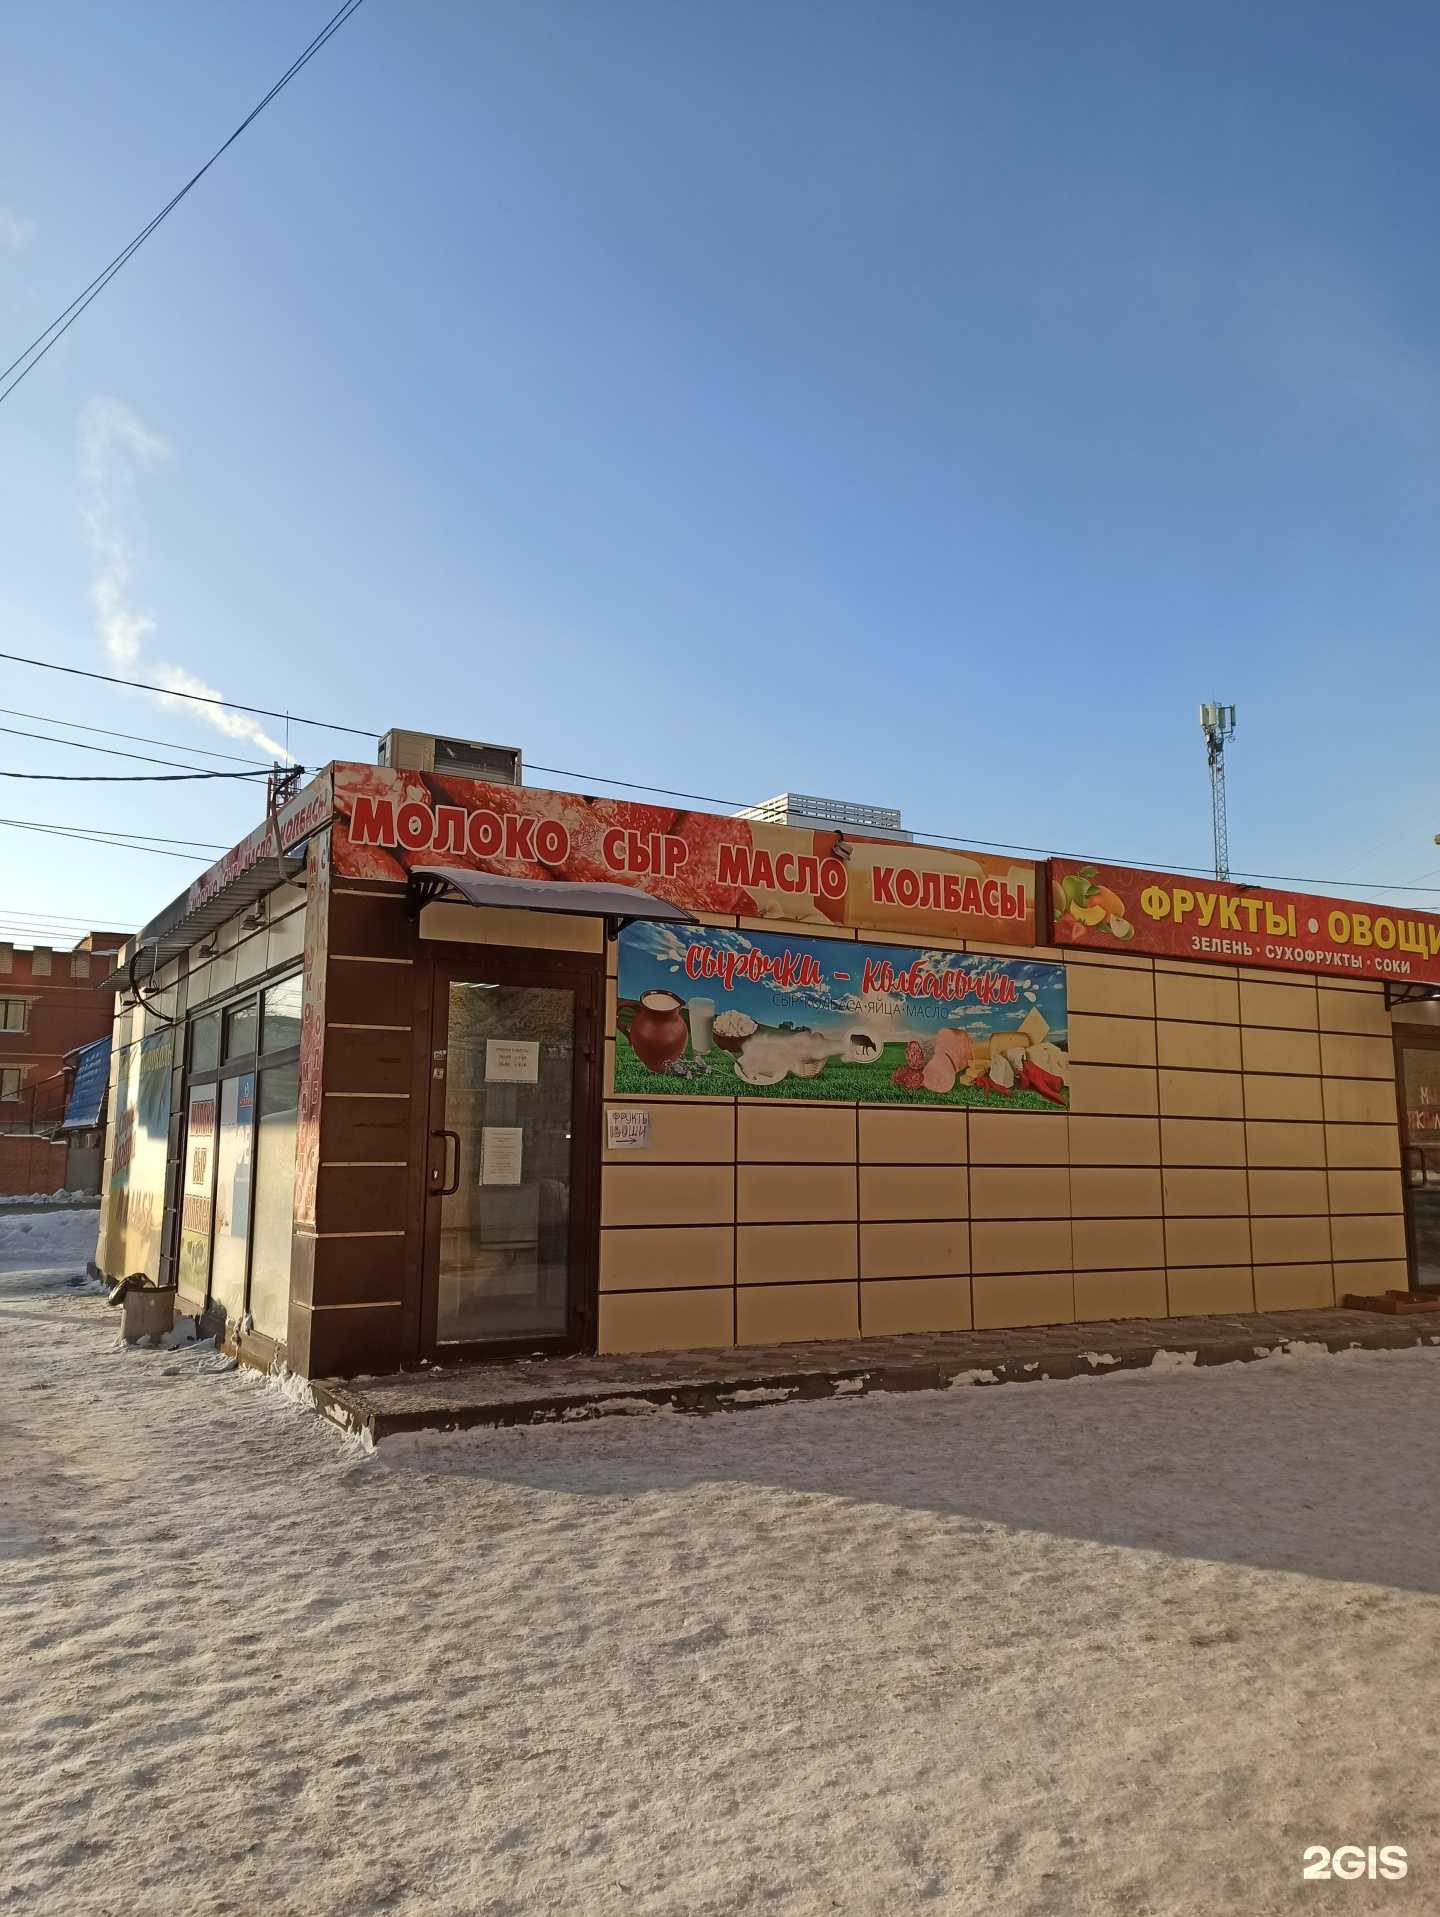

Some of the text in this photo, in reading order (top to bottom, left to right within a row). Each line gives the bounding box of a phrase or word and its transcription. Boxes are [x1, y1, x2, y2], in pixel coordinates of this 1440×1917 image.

[348, 797, 1027, 920] МОЛОКО СЫР МАСЛО КОЛБАСЫ
[1139, 884, 1297, 938] ФРУКТЫ
[685, 943, 823, 992] Сырочки
[861, 958, 1018, 1005] Колбасочки
[1191, 936, 1411, 974] ЗЕЛЕНЬ СУХОФРУКТЫ СОКИ
[867, 999, 901, 1017] ЯЙЦА
[906, 1004, 949, 1020] МАСЛО
